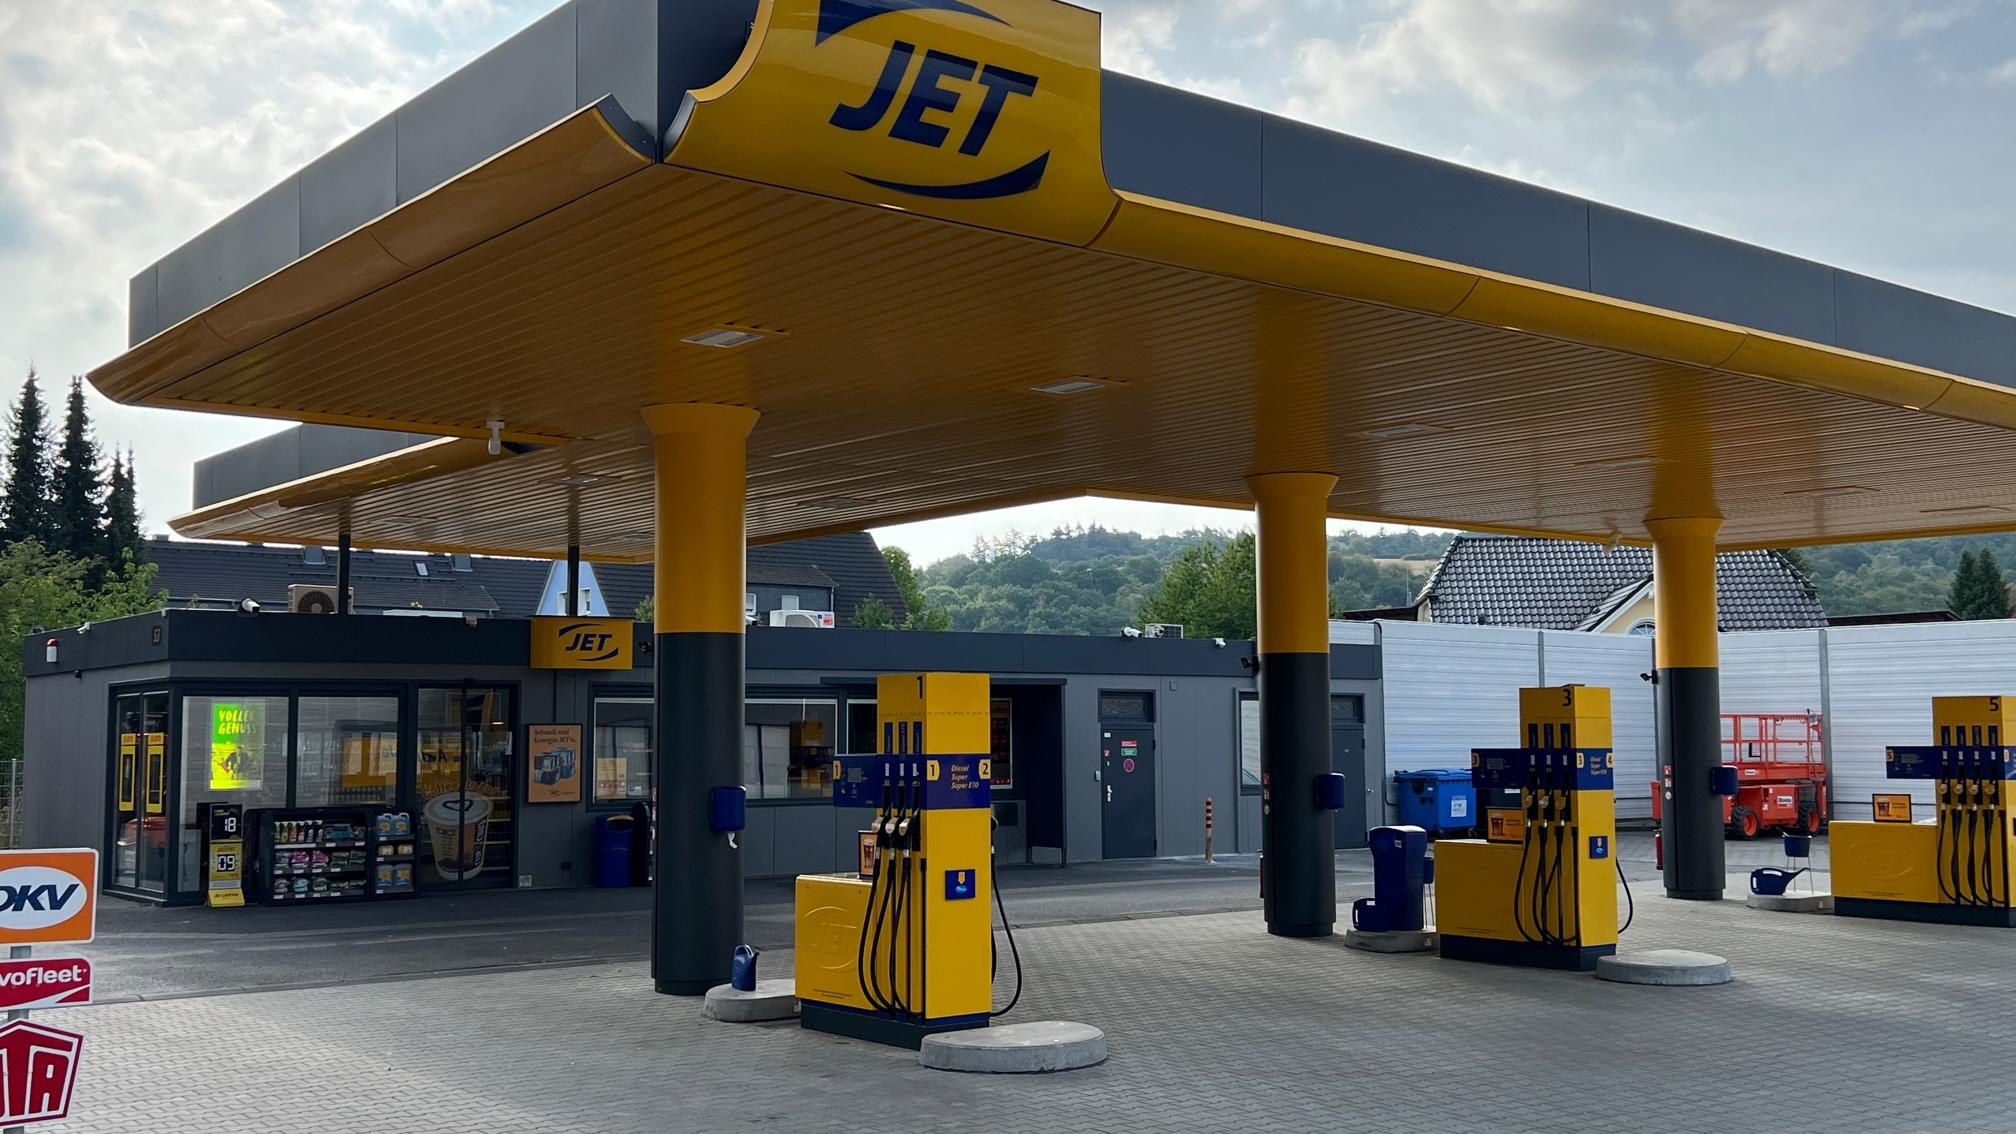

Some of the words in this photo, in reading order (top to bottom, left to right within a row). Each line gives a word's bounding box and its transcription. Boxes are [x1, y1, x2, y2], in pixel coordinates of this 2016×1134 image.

[829, 40, 1039, 156] JET
[565, 634, 613, 652] JET
[916, 676, 923, 699] 1
[1562, 688, 1572, 707] 3
[1989, 697, 1999, 711] 5
[218, 722, 257, 735] GENUSS
[1578, 755, 1583, 765] 3
[1608, 755, 1613, 764] 4
[930, 764, 936, 777] 1
[951, 764, 970, 772] Diesel
[982, 763, 989, 775] 2
[951, 773, 968, 782] Super
[422, 782, 458, 800] Coffee
[951, 782, 968, 791] Super
[968, 781, 979, 789] E10
[224, 817, 237, 832] 18
[218, 855, 236, 871] 09
[0, 883, 80, 912] DKV
[0, 1028, 73, 1117] TA
